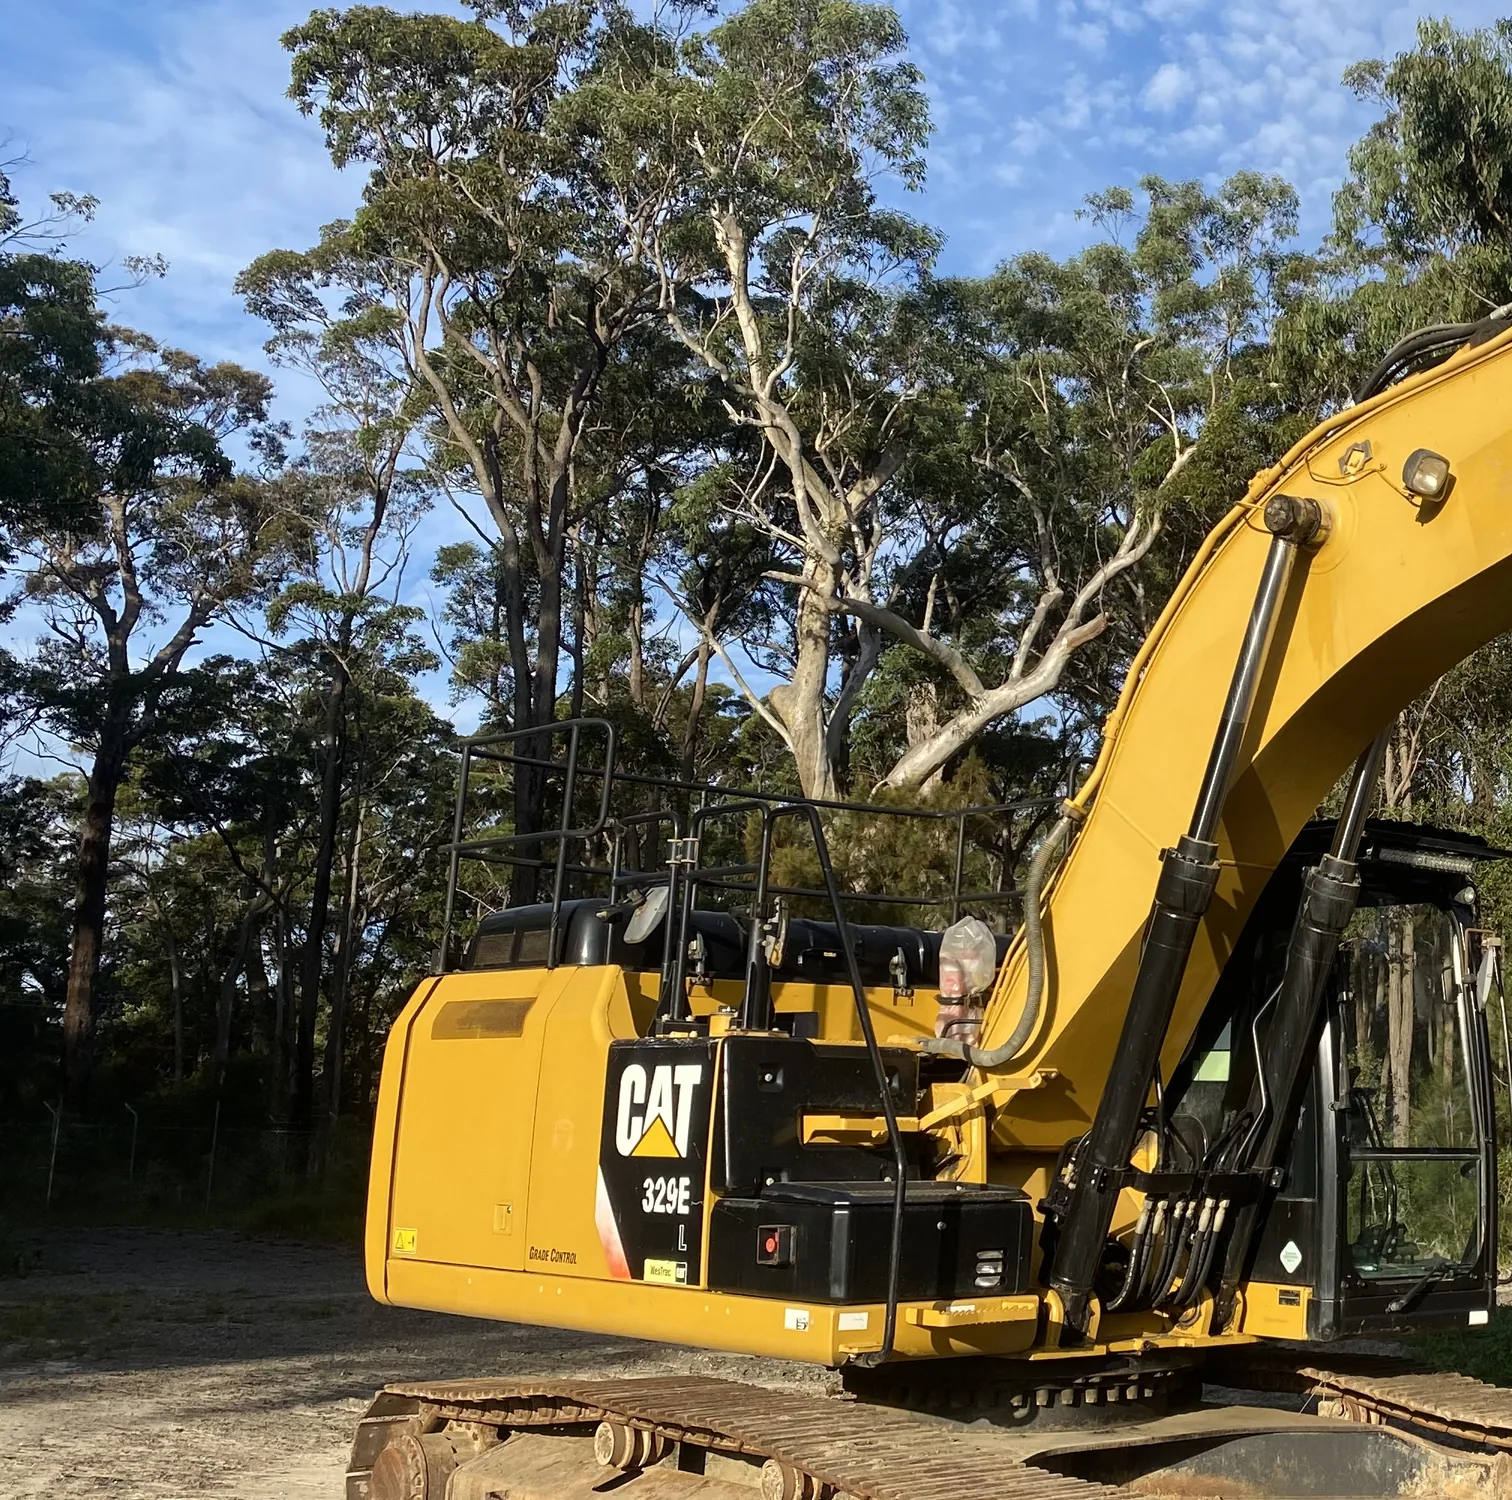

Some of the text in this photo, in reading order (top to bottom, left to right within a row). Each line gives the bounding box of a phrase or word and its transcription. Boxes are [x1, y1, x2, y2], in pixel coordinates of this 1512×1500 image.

[616, 1064, 702, 1158] CAT
[642, 1176, 690, 1214] 329E
[678, 1224, 687, 1251] L
